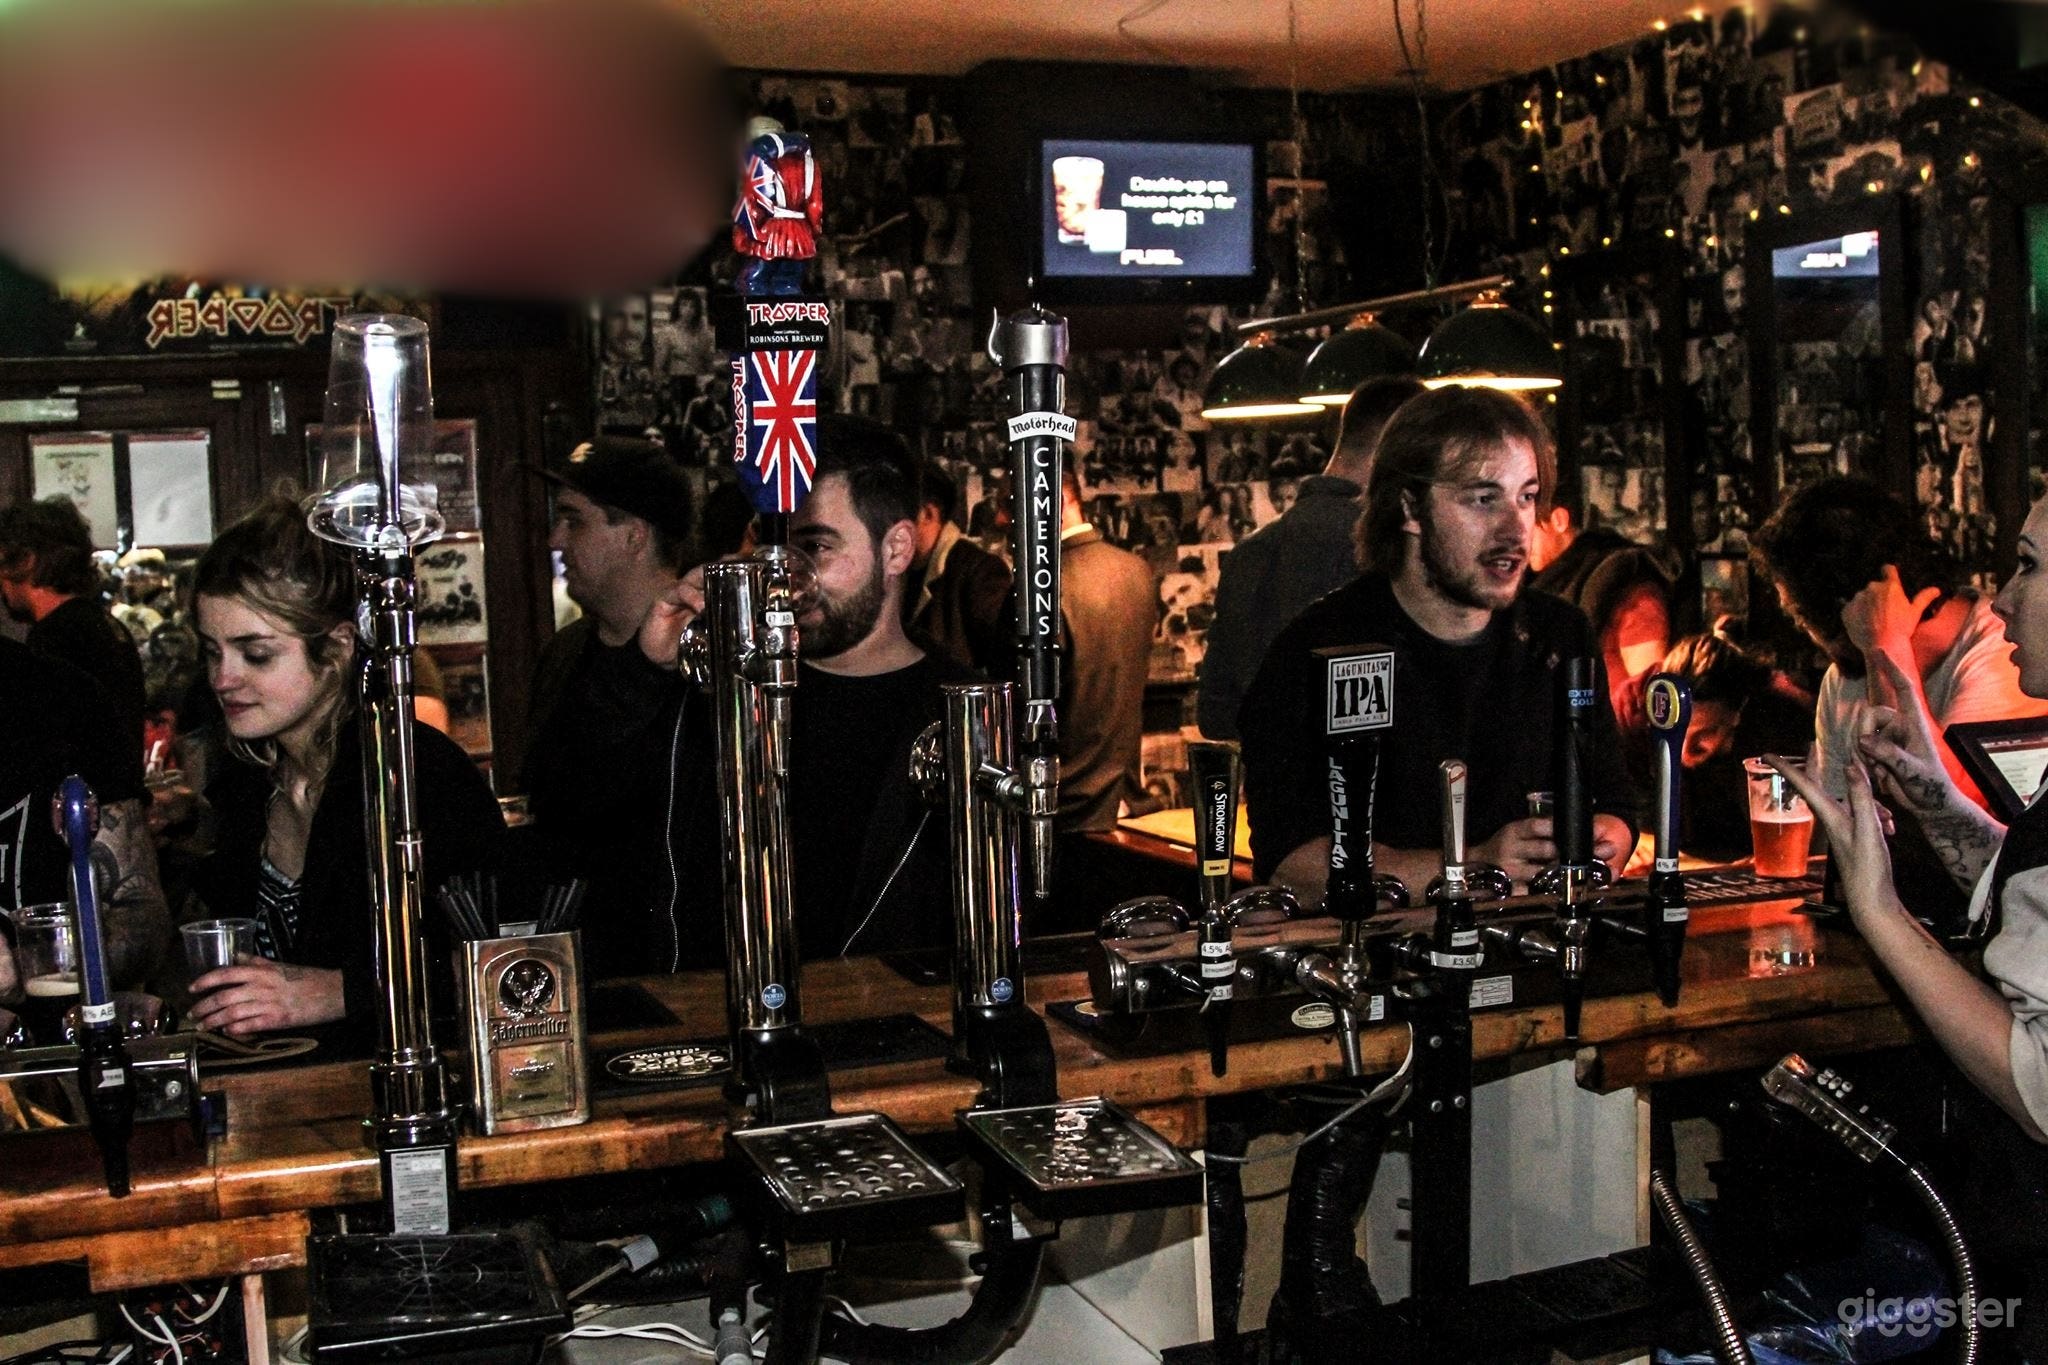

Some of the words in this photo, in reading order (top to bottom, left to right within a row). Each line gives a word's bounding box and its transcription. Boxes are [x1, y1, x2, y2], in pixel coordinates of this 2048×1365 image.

[747, 303, 830, 326] TROOPER
[750, 335, 789, 344] ROBINSONS
[792, 335, 824, 343] BREWERY
[732, 356, 747, 462] TROOPER
[1011, 416, 1075, 435] Motörhead
[1033, 447, 1052, 635] CAMERONS
[1336, 662, 1380, 677] LAGUNITAS
[1334, 675, 1388, 719] IPA
[1215, 793, 1228, 853] STRONGBOW
[1328, 755, 1349, 869] LAGUNITAS
